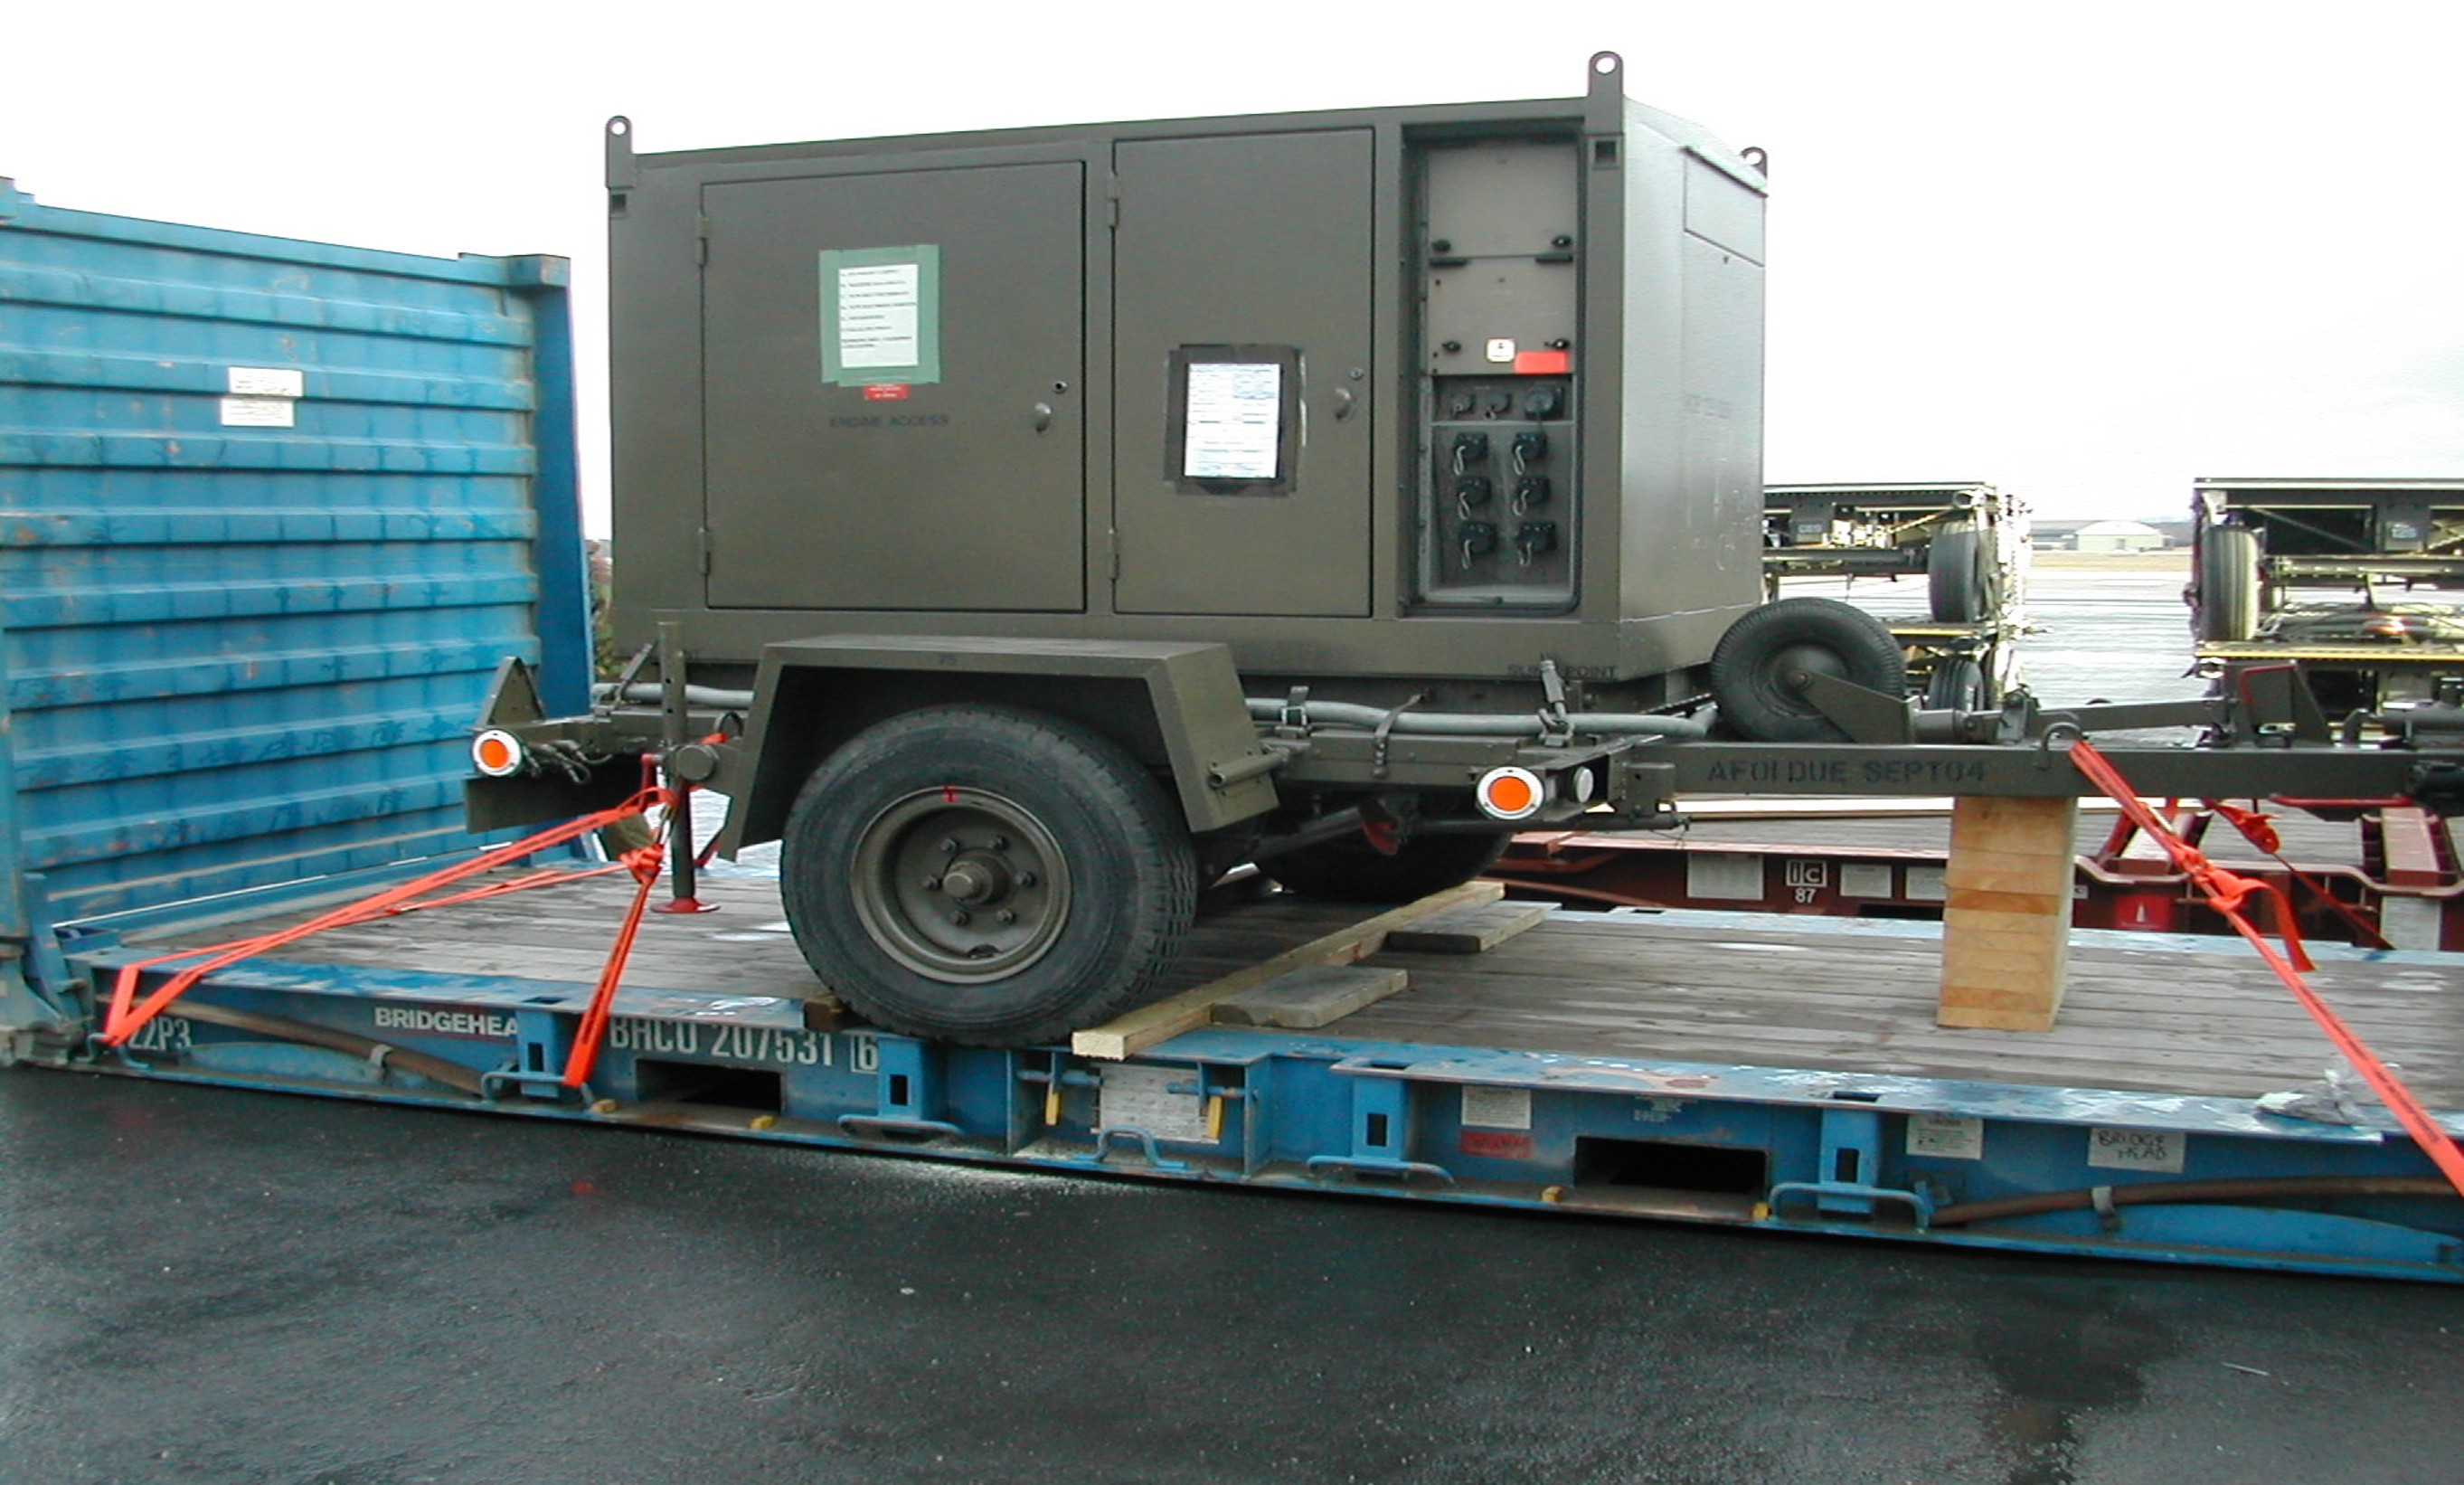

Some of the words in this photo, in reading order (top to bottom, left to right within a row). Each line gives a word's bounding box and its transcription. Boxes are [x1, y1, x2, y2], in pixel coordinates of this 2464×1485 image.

[1786, 760, 1847, 784] DUE
[1795, 887, 1817, 903] 87
[610, 1017, 697, 1055] BHCO
[711, 1023, 834, 1067] 207531
